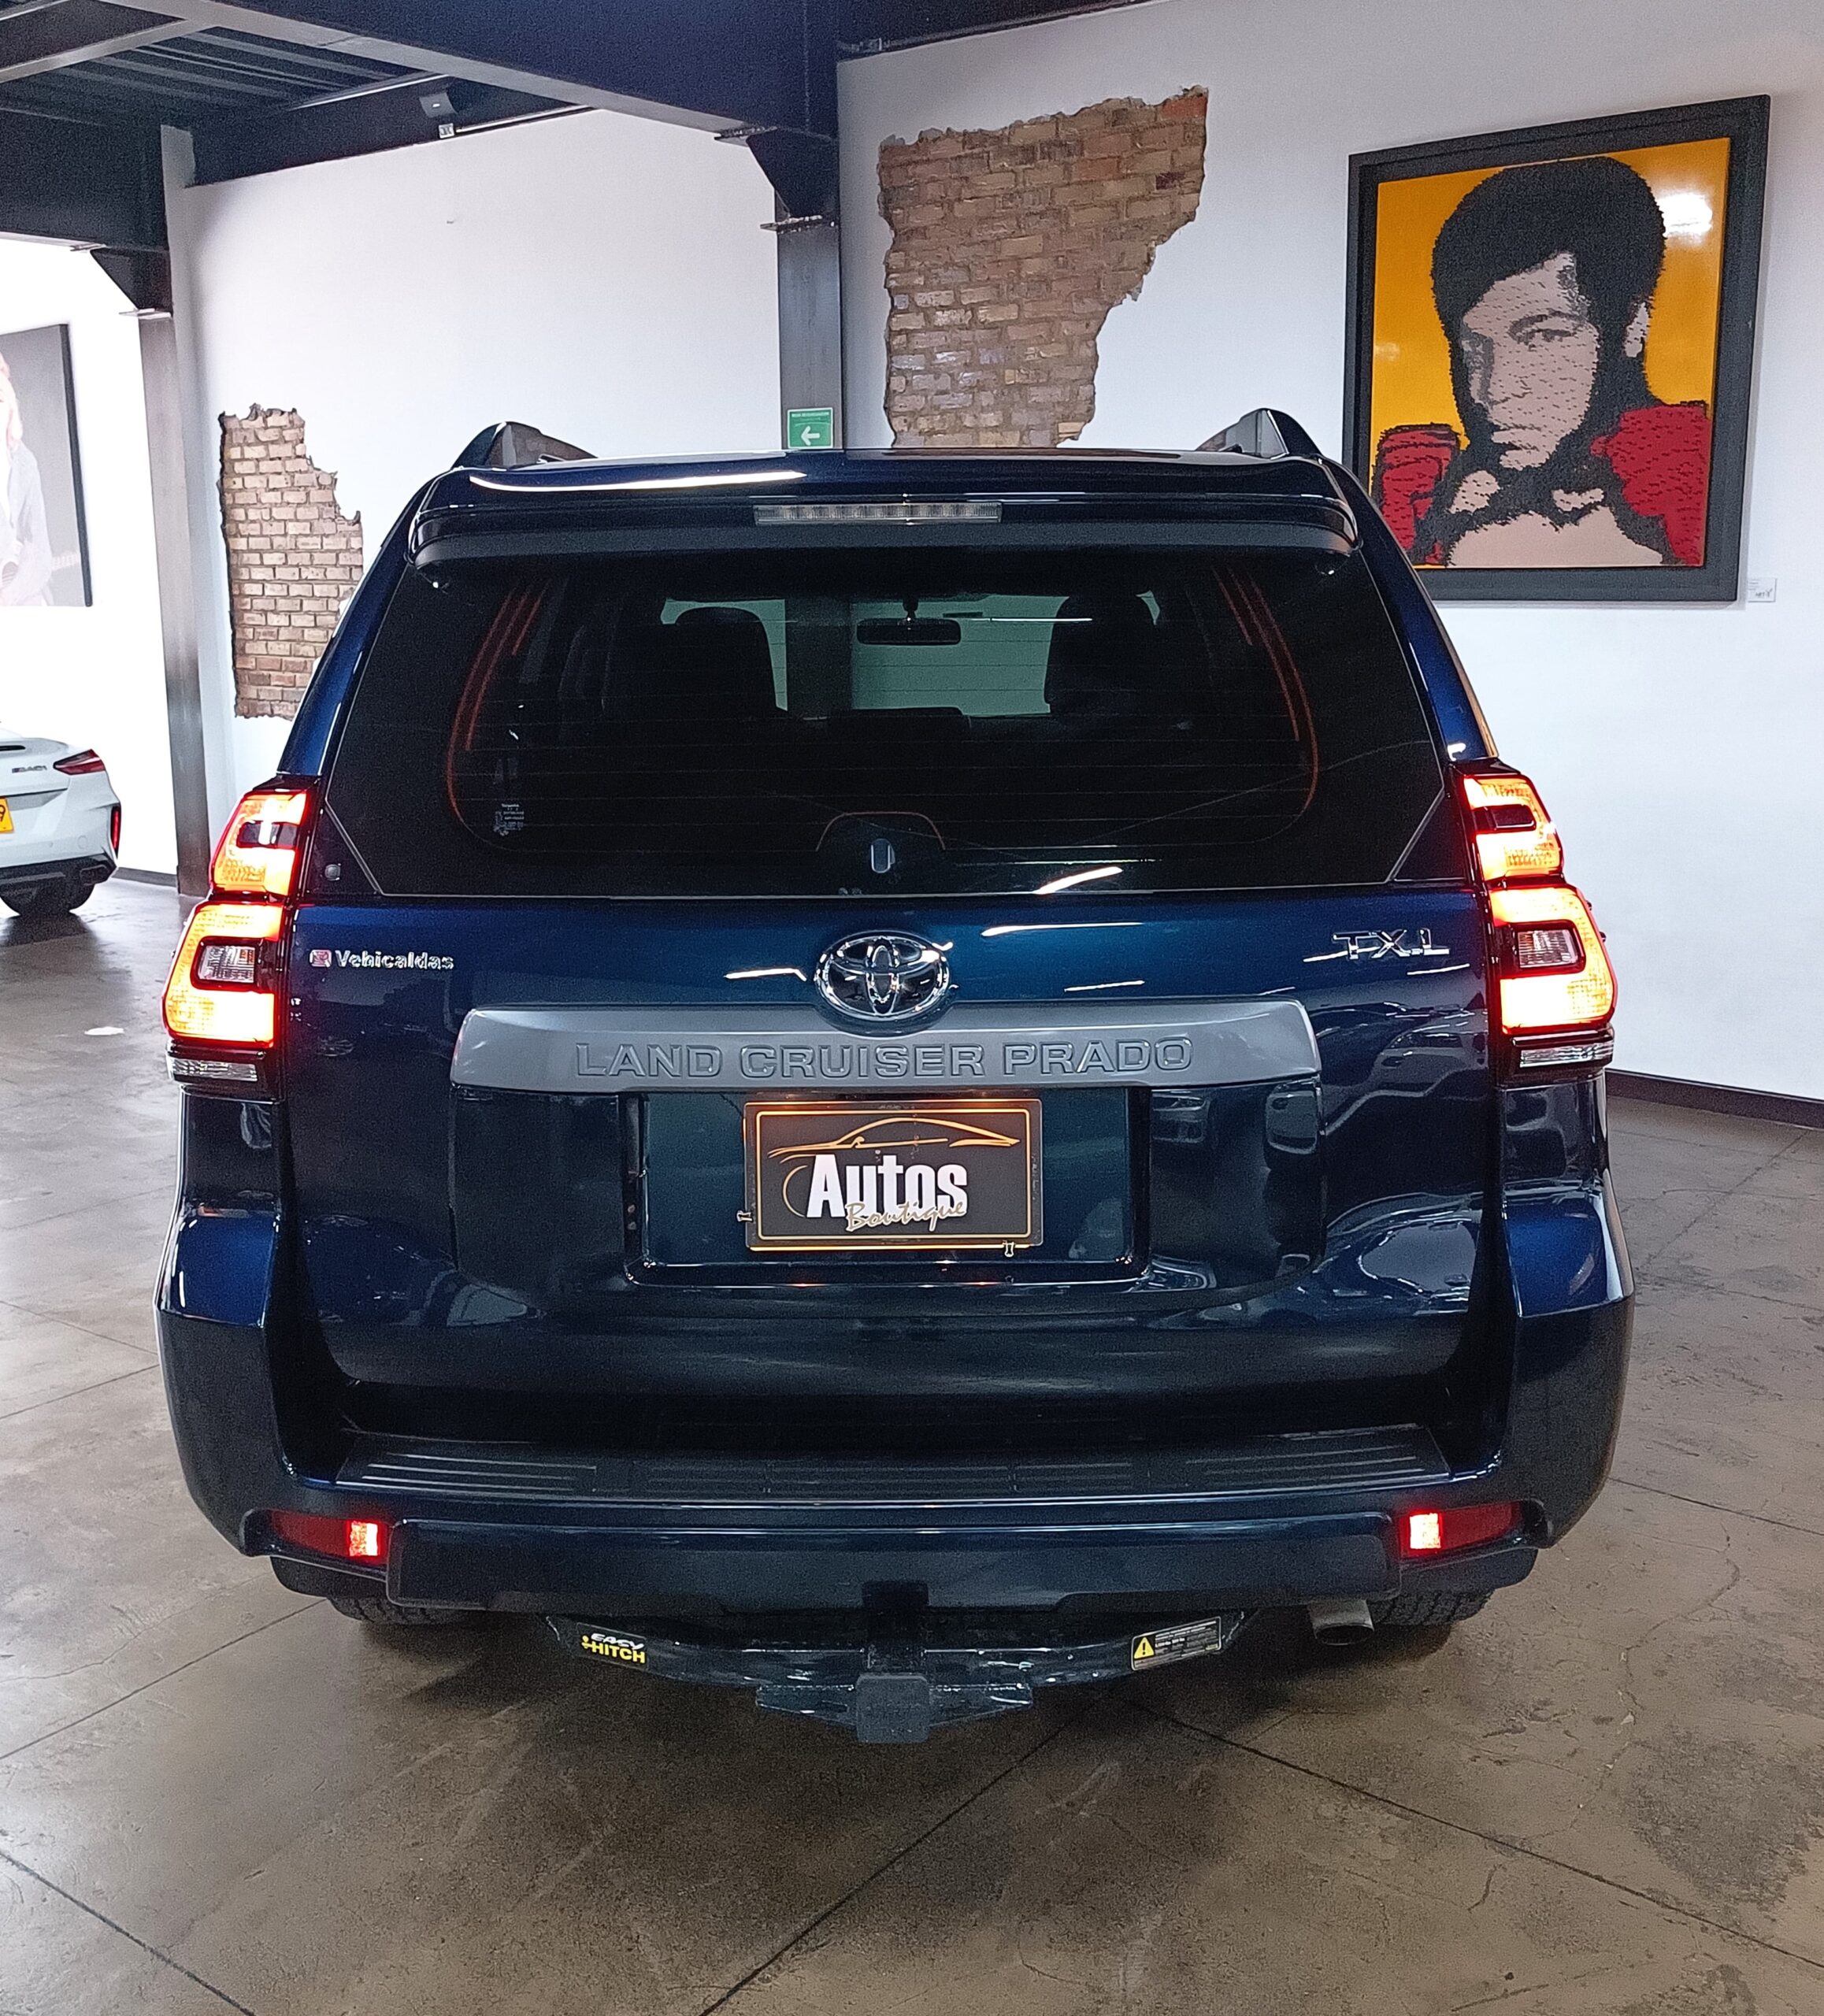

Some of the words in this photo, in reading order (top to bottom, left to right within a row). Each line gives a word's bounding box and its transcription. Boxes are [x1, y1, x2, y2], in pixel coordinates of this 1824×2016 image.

[335, 950, 454, 970] Vehicaldas
[576, 1043, 723, 1077] LAND
[740, 1043, 985, 1078] CRUISER
[1003, 1036, 1193, 1076] PRADO
[806, 1154, 968, 1218] Autos
[844, 1201, 967, 1232] Boutique
[591, 1632, 644, 1651] EASY
[591, 1641, 646, 1664] HITCH
